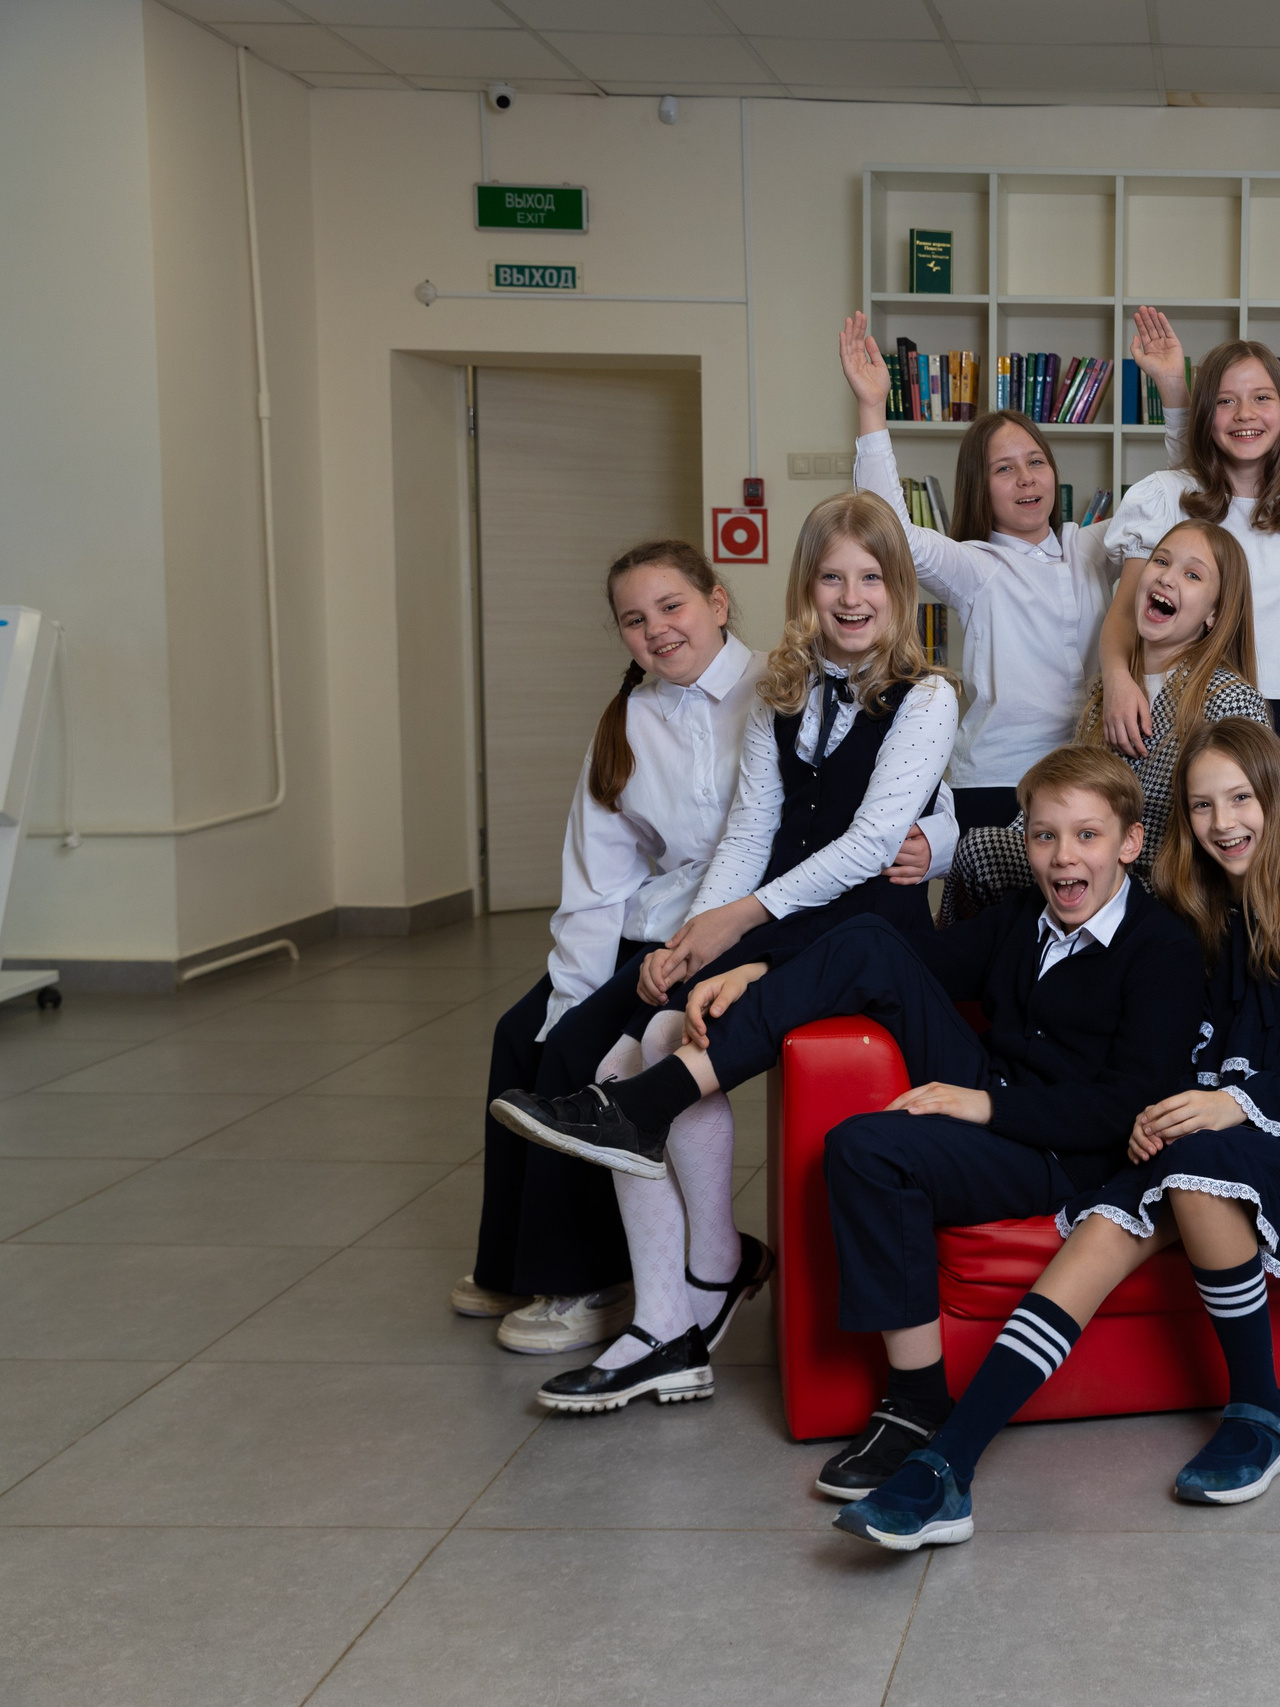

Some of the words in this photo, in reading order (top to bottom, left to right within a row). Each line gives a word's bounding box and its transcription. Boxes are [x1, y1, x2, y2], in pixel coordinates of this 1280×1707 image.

[505, 192, 555, 211] ВЫХОД
[517, 212, 546, 224] EXIT
[499, 267, 573, 288] ВЫХОД
